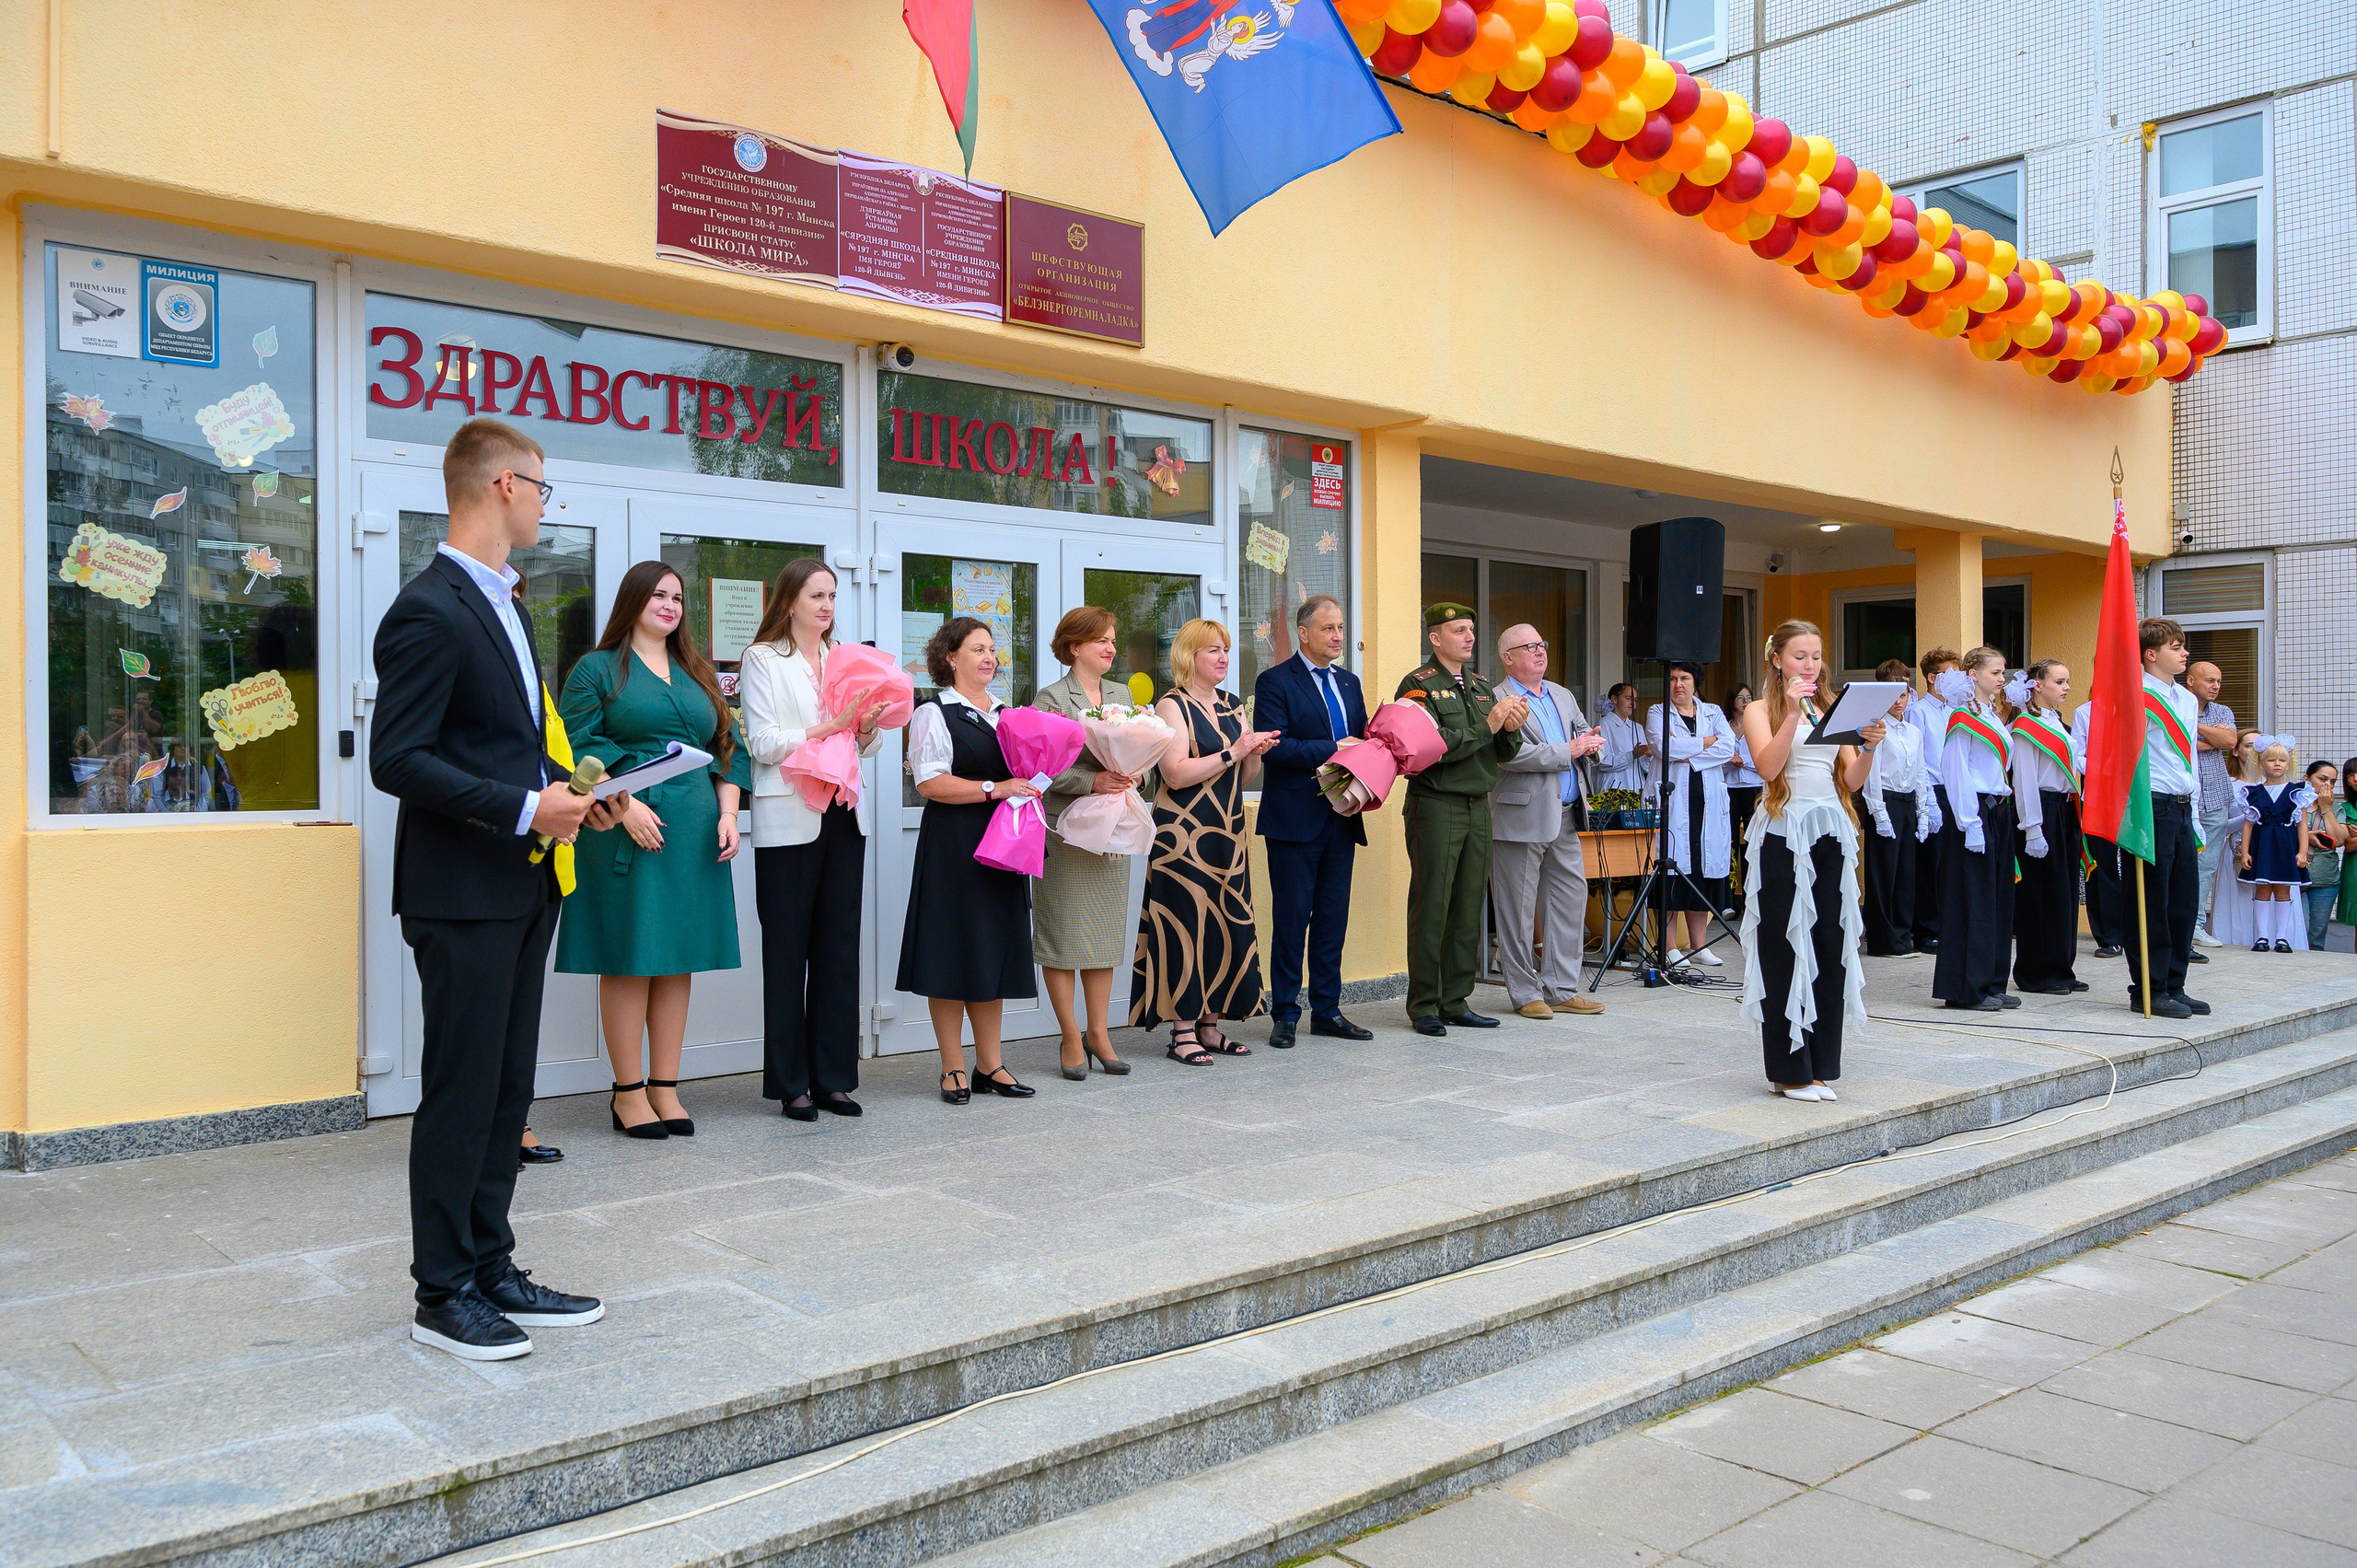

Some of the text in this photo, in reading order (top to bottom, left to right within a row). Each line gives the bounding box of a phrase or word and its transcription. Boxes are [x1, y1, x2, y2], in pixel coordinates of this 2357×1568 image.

[702, 165, 798, 193] ГОСУДАРСТВЕННОМУ
[850, 172, 911, 190] РЭСПУБЛІКА БЕЛАРУСЬ
[681, 172, 816, 208] УЧРЕЖДЕНИЮ ОБРАЗОВАНИЯ
[661, 183, 711, 203] «Средняя
[714, 196, 748, 210] школа
[766, 204, 784, 218] 197
[786, 212, 794, 220] г.
[796, 212, 835, 228] Минска
[935, 192, 993, 209] РЕСПУБЛИКА БЕЛАРУСЬ
[672, 203, 825, 239] имени Героев 120-й дивизии»
[860, 206, 901, 220] ДЗЯРЖАЎНАЯ
[703, 223, 796, 249] ПРИСВОЕН СТАТУС
[865, 222, 899, 233] АДУКАЦЫІ
[937, 224, 993, 239] ГОСУДАРСТВЕННОЕ
[841, 230, 922, 253] «СЯРЭДНЯЯ ШКОЛА
[944, 239, 985, 252] ОБРАЗОВАНИЯ
[946, 232, 984, 246] УЧРЕЖДЕНИЕ
[690, 235, 809, 267] «ШКОЛА МИРА»
[882, 250, 915, 262] МІНСКА
[925, 249, 1000, 270] «СРЕДНЯЯ ШКОЛА
[854, 266, 872, 274] 120-Й
[859, 255, 901, 269] ІМЯ ГЕРОЯЎ
[1031, 250, 1122, 280] ШЕФСТВУЮЩАЯ
[146, 264, 215, 283] МИЛИЦИЯ
[937, 271, 988, 286] ИМЕНИ ГЕРОЕВ
[962, 266, 996, 280] МИНСКА
[1037, 267, 1117, 293] ОРГАНИЗАЦИЯ
[70, 282, 128, 295] ВНИМАНИЕ
[1018, 283, 1134, 311] ОТКРЫТОЕ АКЦИОНЕРНОЕ ОБЩЕСТВО
[1013, 295, 1138, 329] «БЕЛЭНЕРГОРЕМНАЛАДКА»
[221, 395, 250, 413] Буду
[370, 326, 839, 467] ЗДРАВСТВУЙ,
[212, 397, 274, 432] отличницей!
[1314, 478, 1341, 490] ЗДЕСЬ
[1314, 498, 1341, 506] МИЛИЦИЮ
[1257, 525, 1280, 544] Вперёд
[105, 539, 159, 567] уже жду
[1255, 537, 1283, 554] знаниям!
[104, 552, 152, 575] осенние
[231, 678, 276, 700] Люблю
[234, 687, 284, 715] учиться!
